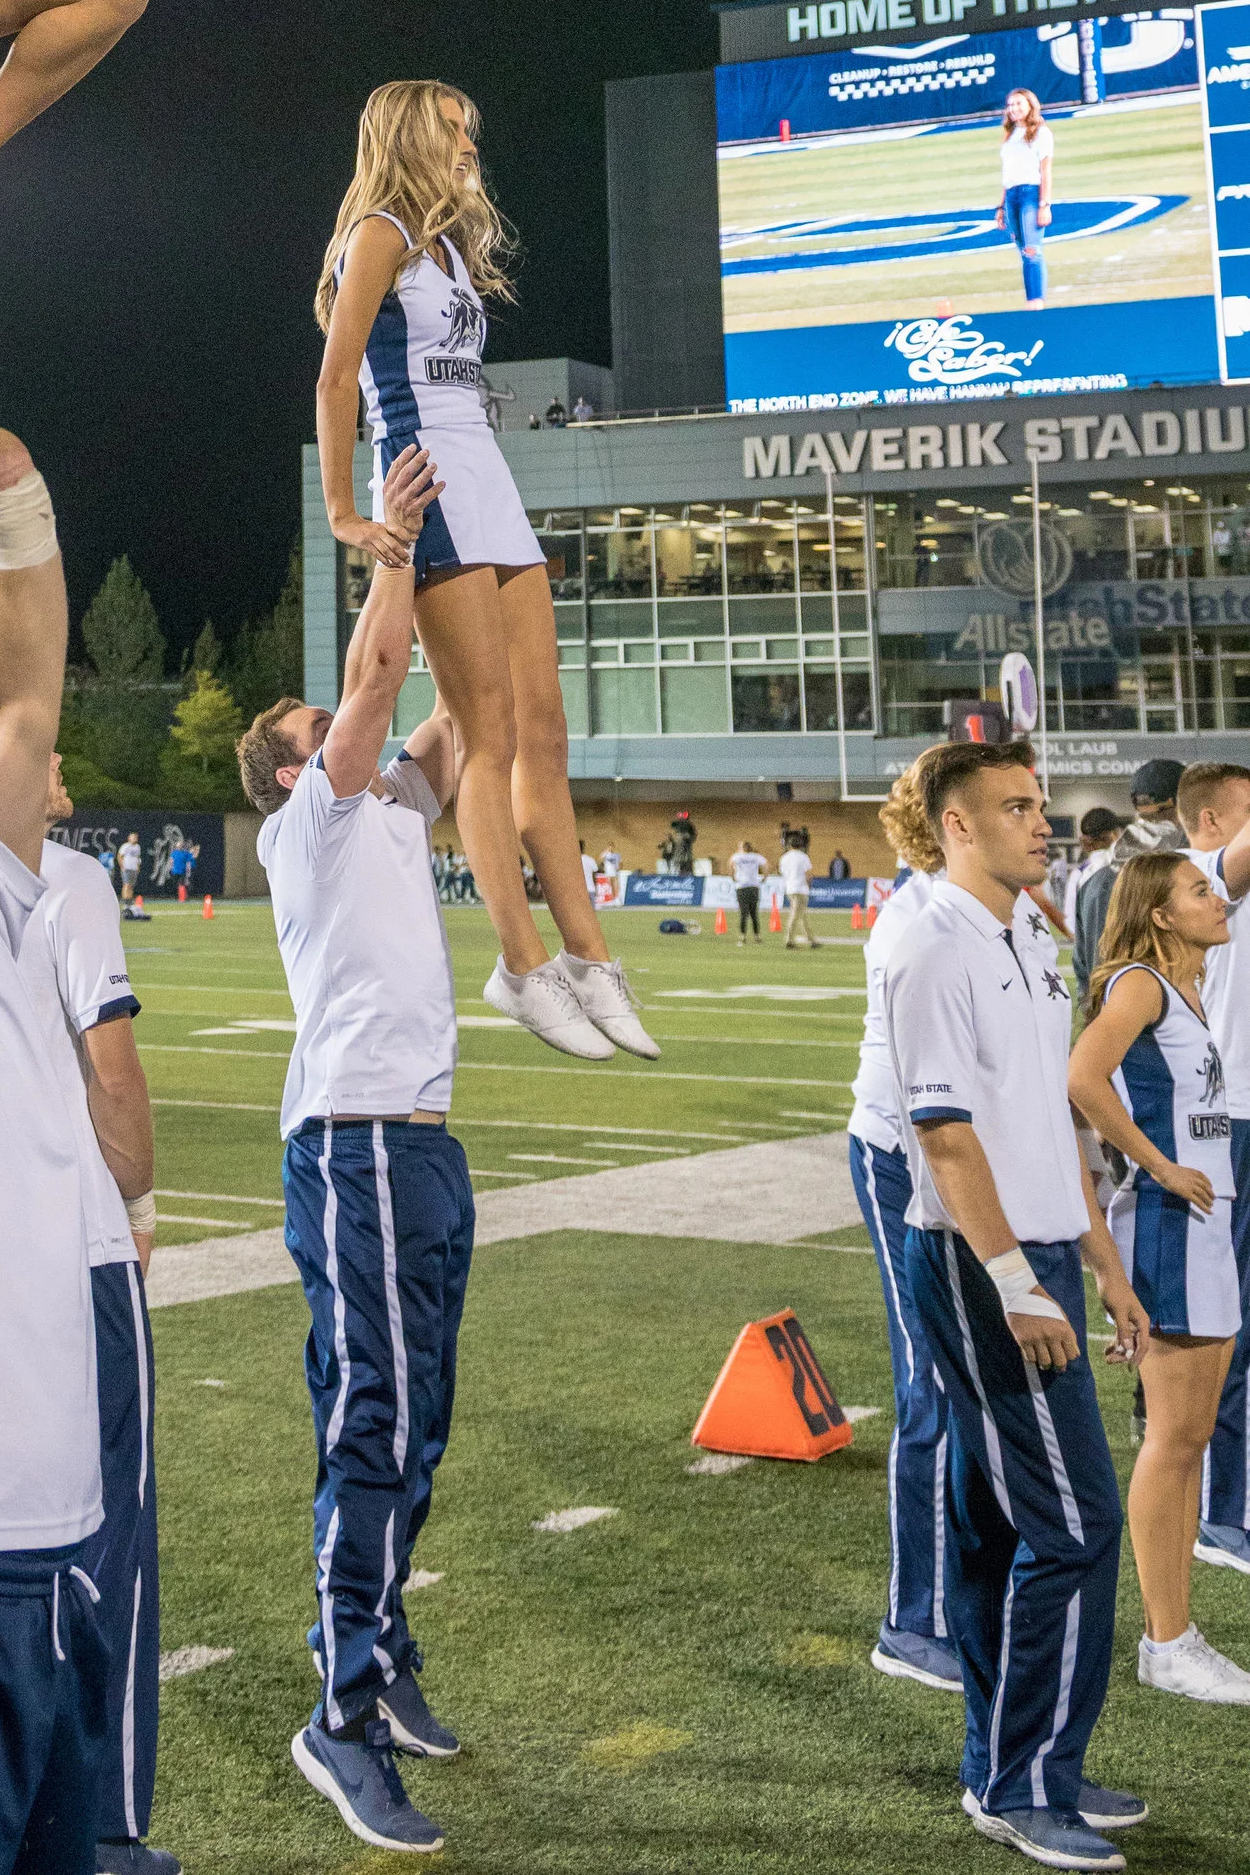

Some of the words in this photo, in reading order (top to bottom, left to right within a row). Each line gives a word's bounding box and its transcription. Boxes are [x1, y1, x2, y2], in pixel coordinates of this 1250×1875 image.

[945, 53, 996, 71] REBUILD
[729, 399, 757, 413] THE
[758, 396, 806, 412] NORTH
[807, 393, 839, 409] END
[883, 388, 908, 404] WE
[909, 385, 948, 402] HAVE
[743, 421, 1010, 478] MAVERIK
[1068, 742, 1118, 755] LAUB
[926, 1084, 953, 1093] STATE
